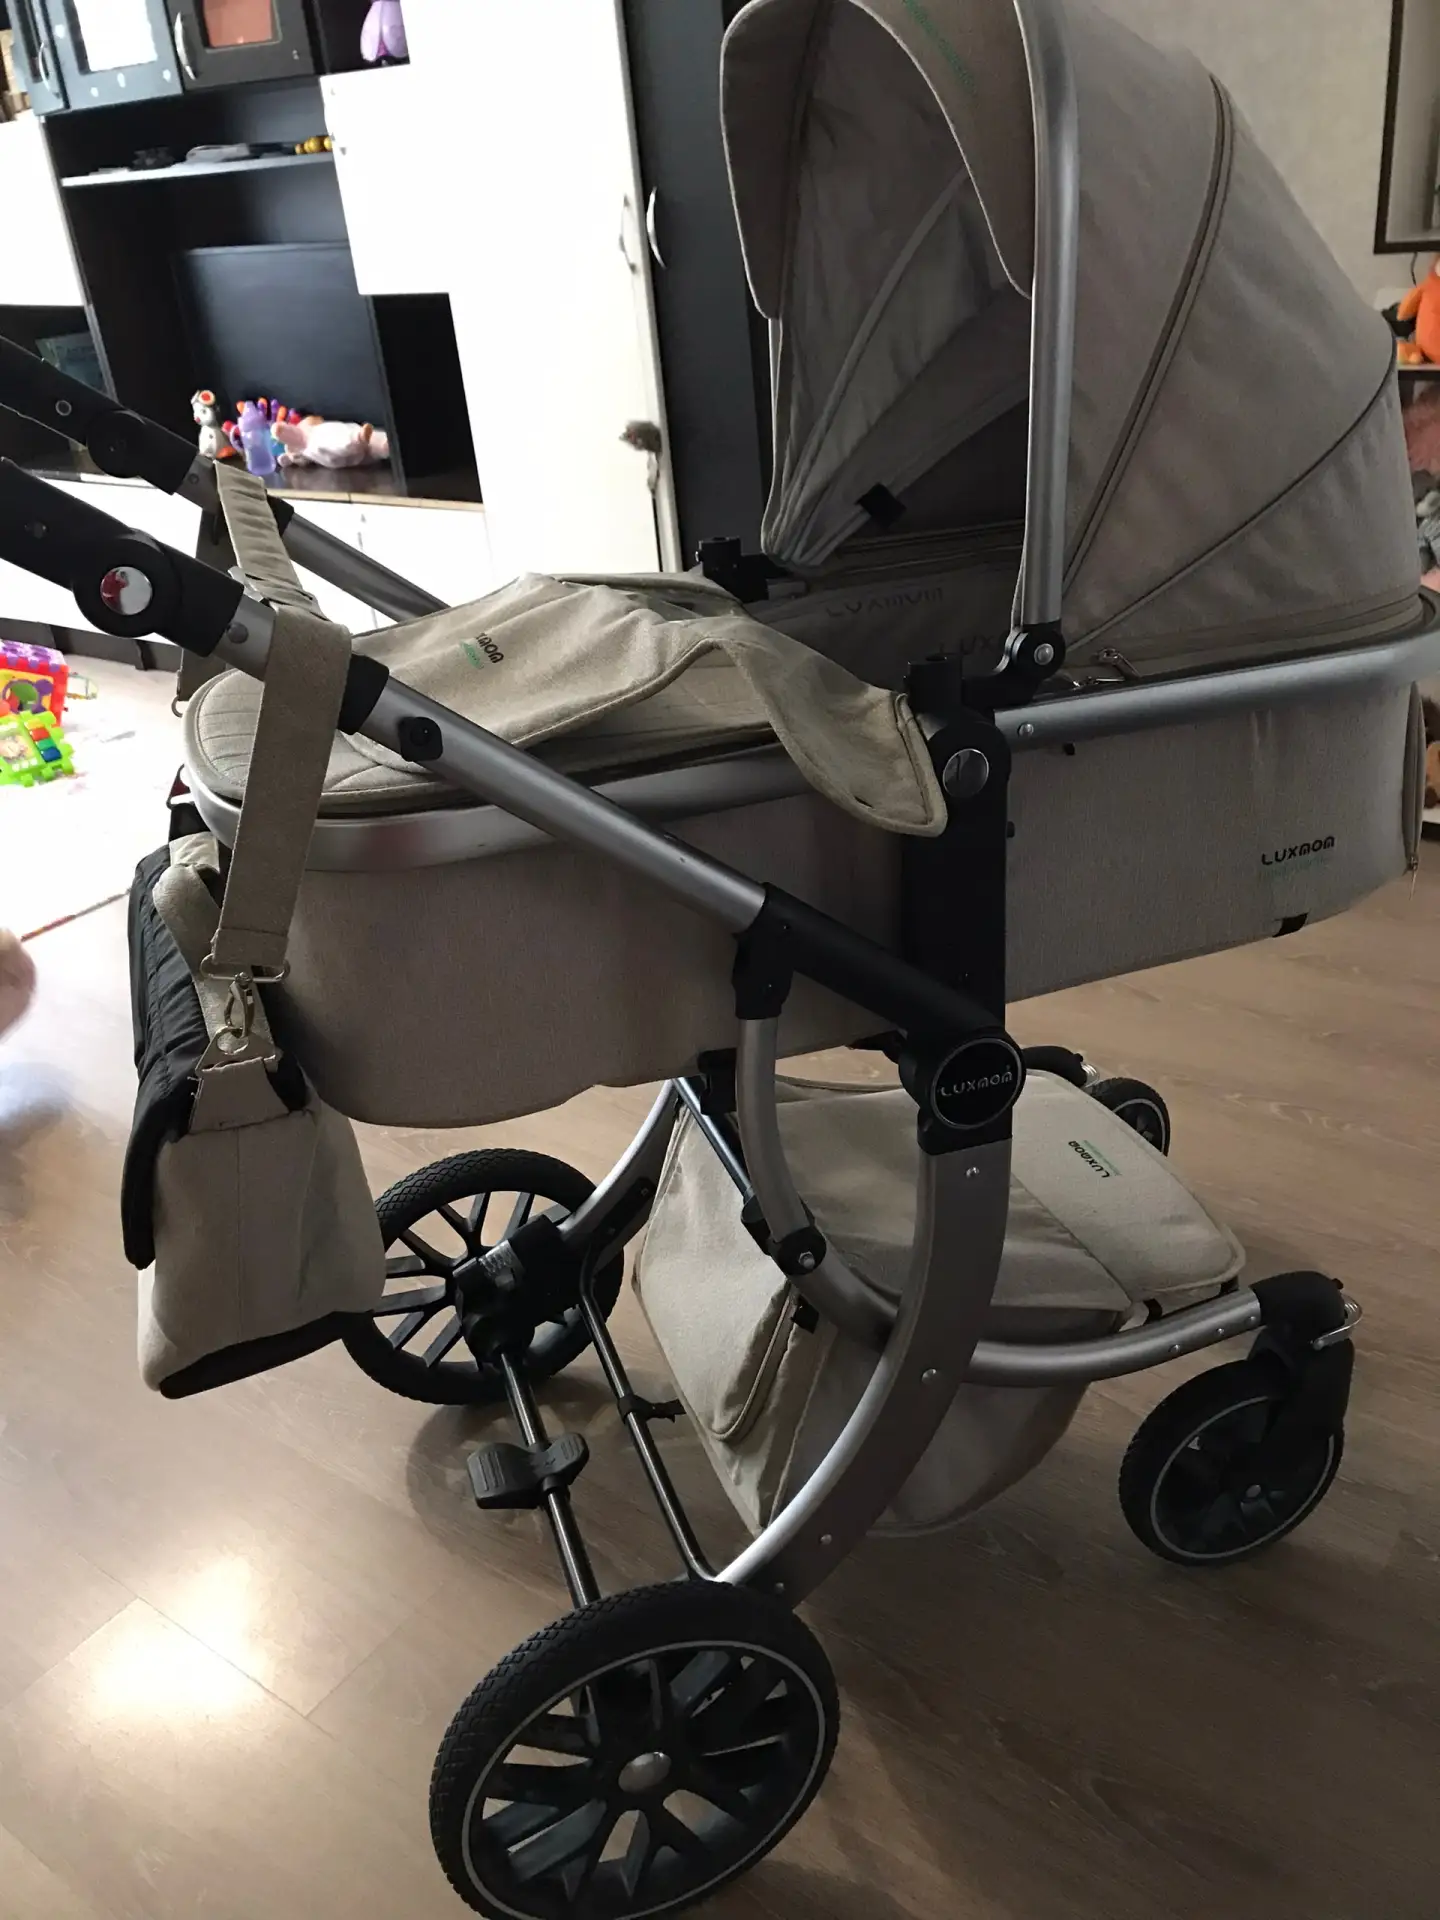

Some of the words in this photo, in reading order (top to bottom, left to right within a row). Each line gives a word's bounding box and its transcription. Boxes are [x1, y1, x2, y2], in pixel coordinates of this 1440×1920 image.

[1261, 835, 1335, 866] LUXMOM
[940, 1071, 1013, 1097] LUXMOM
[1068, 1140, 1110, 1178] LUXMOM
